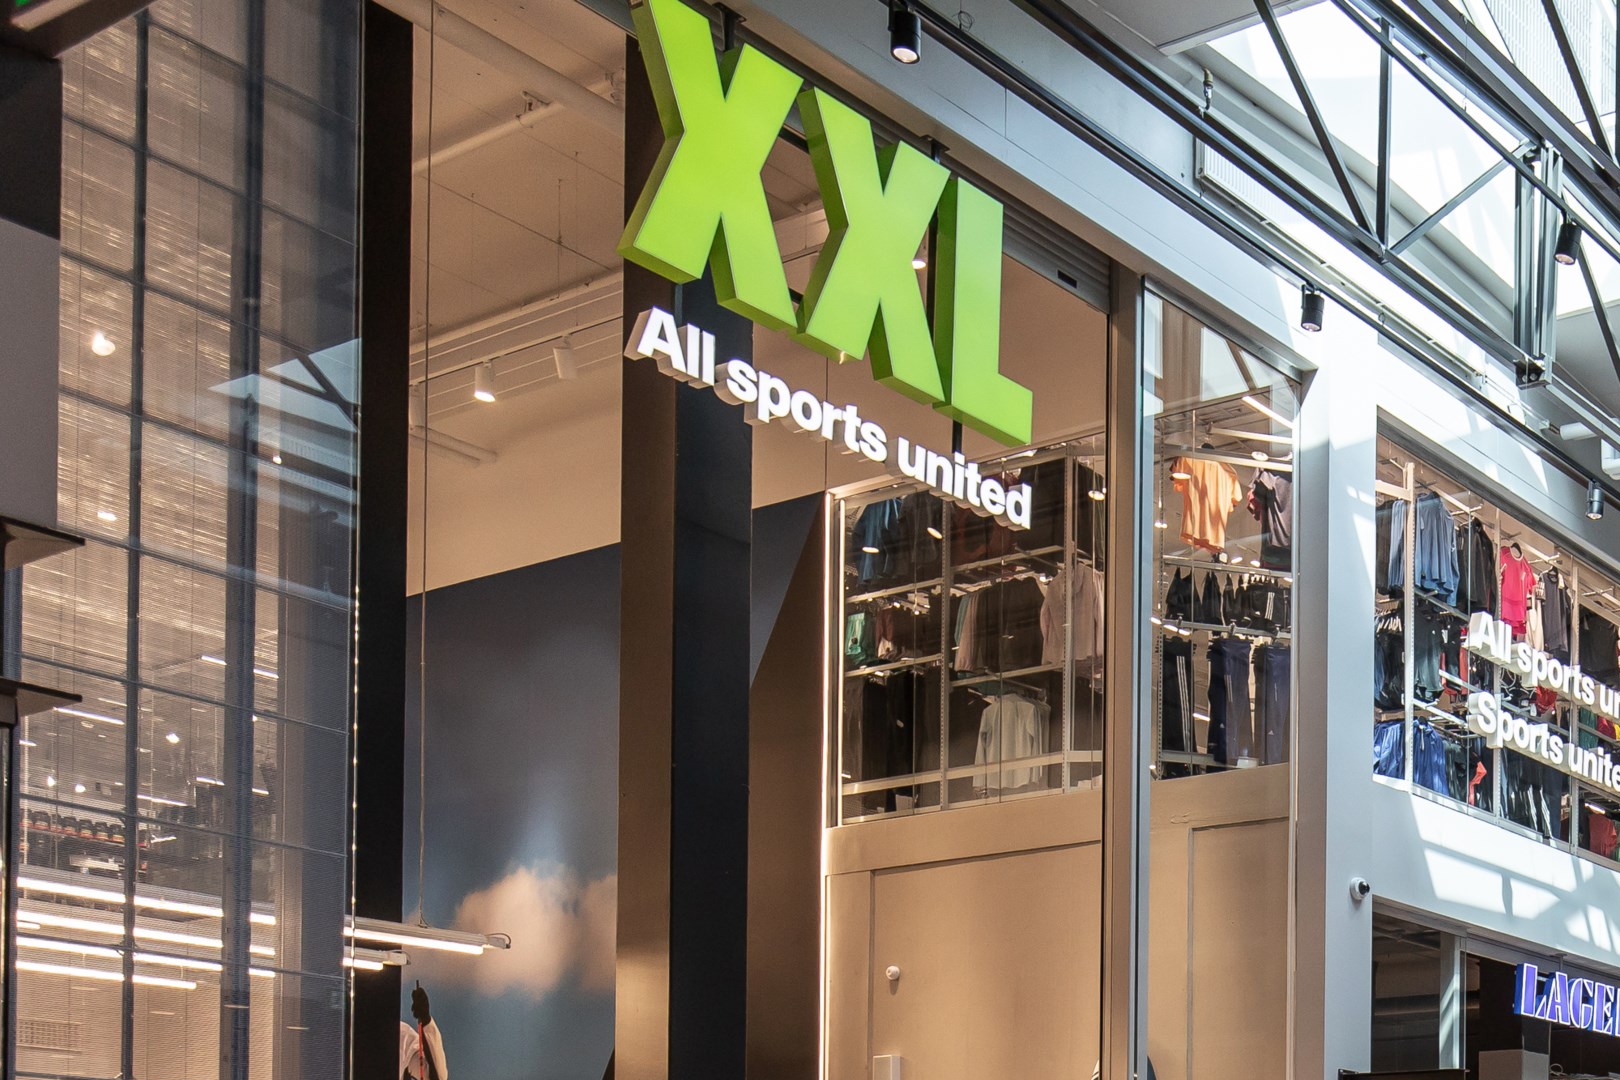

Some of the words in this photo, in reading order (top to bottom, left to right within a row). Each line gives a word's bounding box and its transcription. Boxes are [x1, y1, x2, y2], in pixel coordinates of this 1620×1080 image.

[622, 0, 1033, 446] XXL
[628, 306, 716, 388] All
[720, 358, 888, 463] sports
[896, 436, 1032, 530] united
[1465, 611, 1513, 665] All
[1515, 642, 1595, 706] sports
[1471, 691, 1564, 765] Sports
